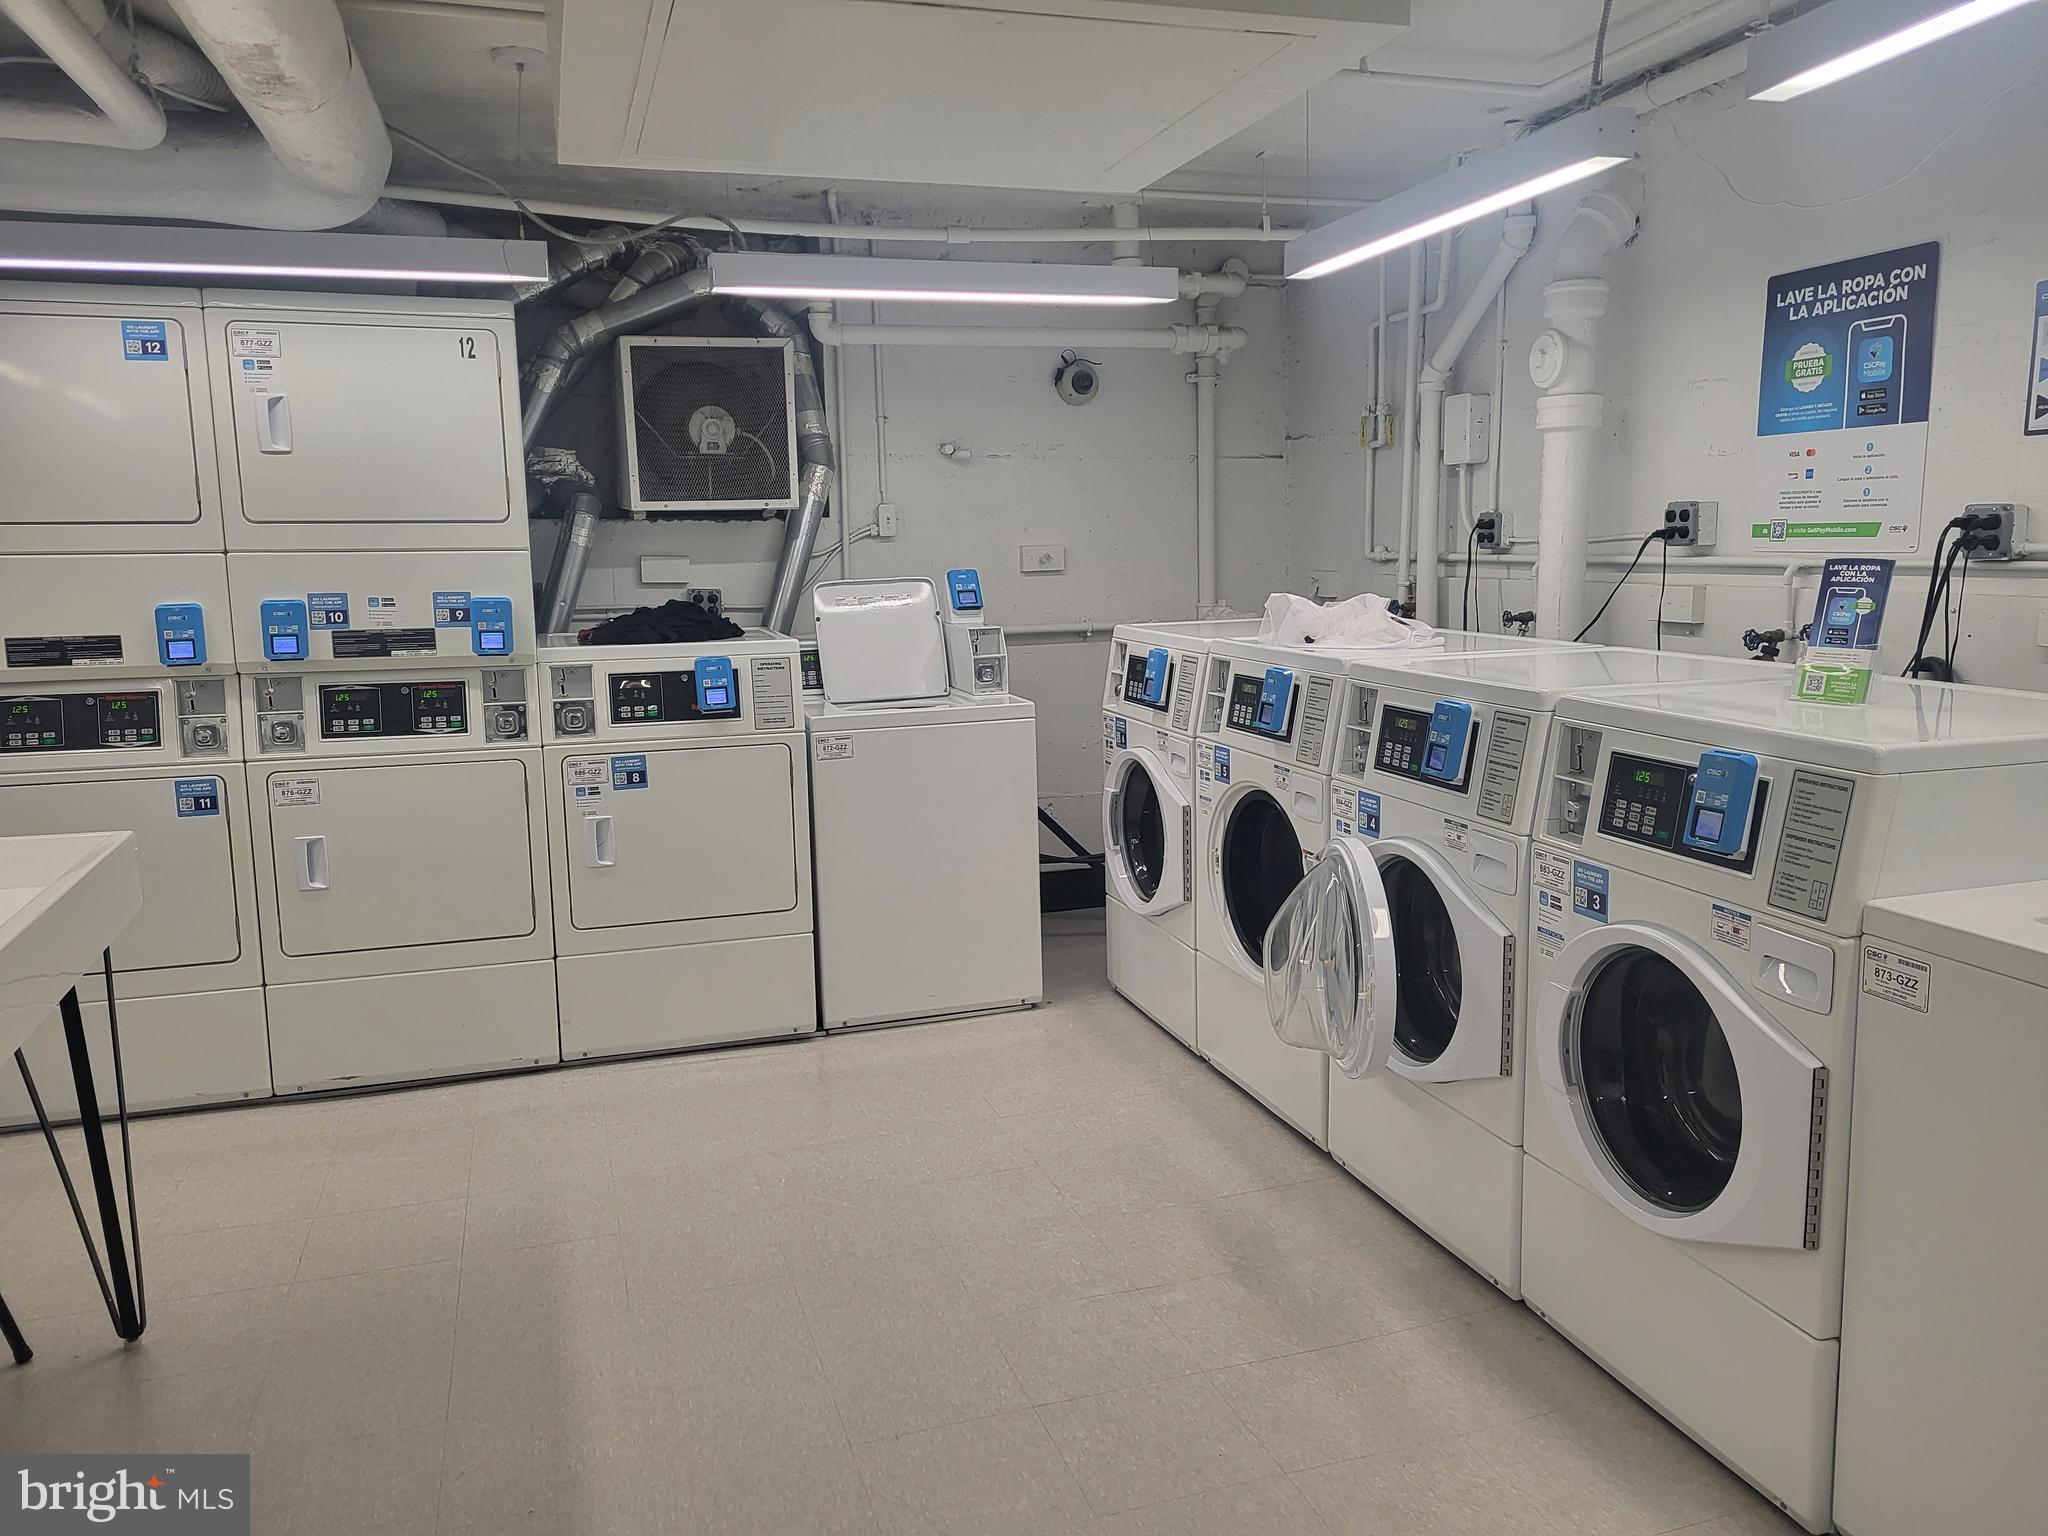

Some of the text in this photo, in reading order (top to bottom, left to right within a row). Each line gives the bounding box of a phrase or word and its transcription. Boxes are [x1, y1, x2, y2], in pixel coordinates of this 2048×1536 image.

[1776, 263, 1927, 308] LAVE LA ROPA CON
[1789, 285, 1909, 321] LA APLICACIÓN
[145, 342, 161, 354] 12
[240, 339, 273, 347] 877-GZZ
[459, 336, 476, 359] 12
[1793, 358, 1825, 370] PRUEBA
[1795, 366, 1824, 378] GRATIS
[1863, 369, 1886, 377] Mobile
[1807, 526, 1857, 535] GetPayMobile.com
[1830, 575, 1875, 583] APLICACIÓN
[328, 612, 344, 623] 10
[455, 610, 464, 621] 9
[1222, 766, 1227, 777] 5
[1707, 768, 1722, 777] CSC
[632, 773, 640, 783] 8
[281, 788, 313, 797] 876-GZZ
[199, 798, 211, 809] 11
[1370, 817, 1376, 830] 4
[1539, 864, 1565, 880] 883-GZZ
[1592, 894, 1601, 910] 3
[1866, 949, 1883, 959] CSC
[1874, 967, 1919, 991] 873-GZZ
